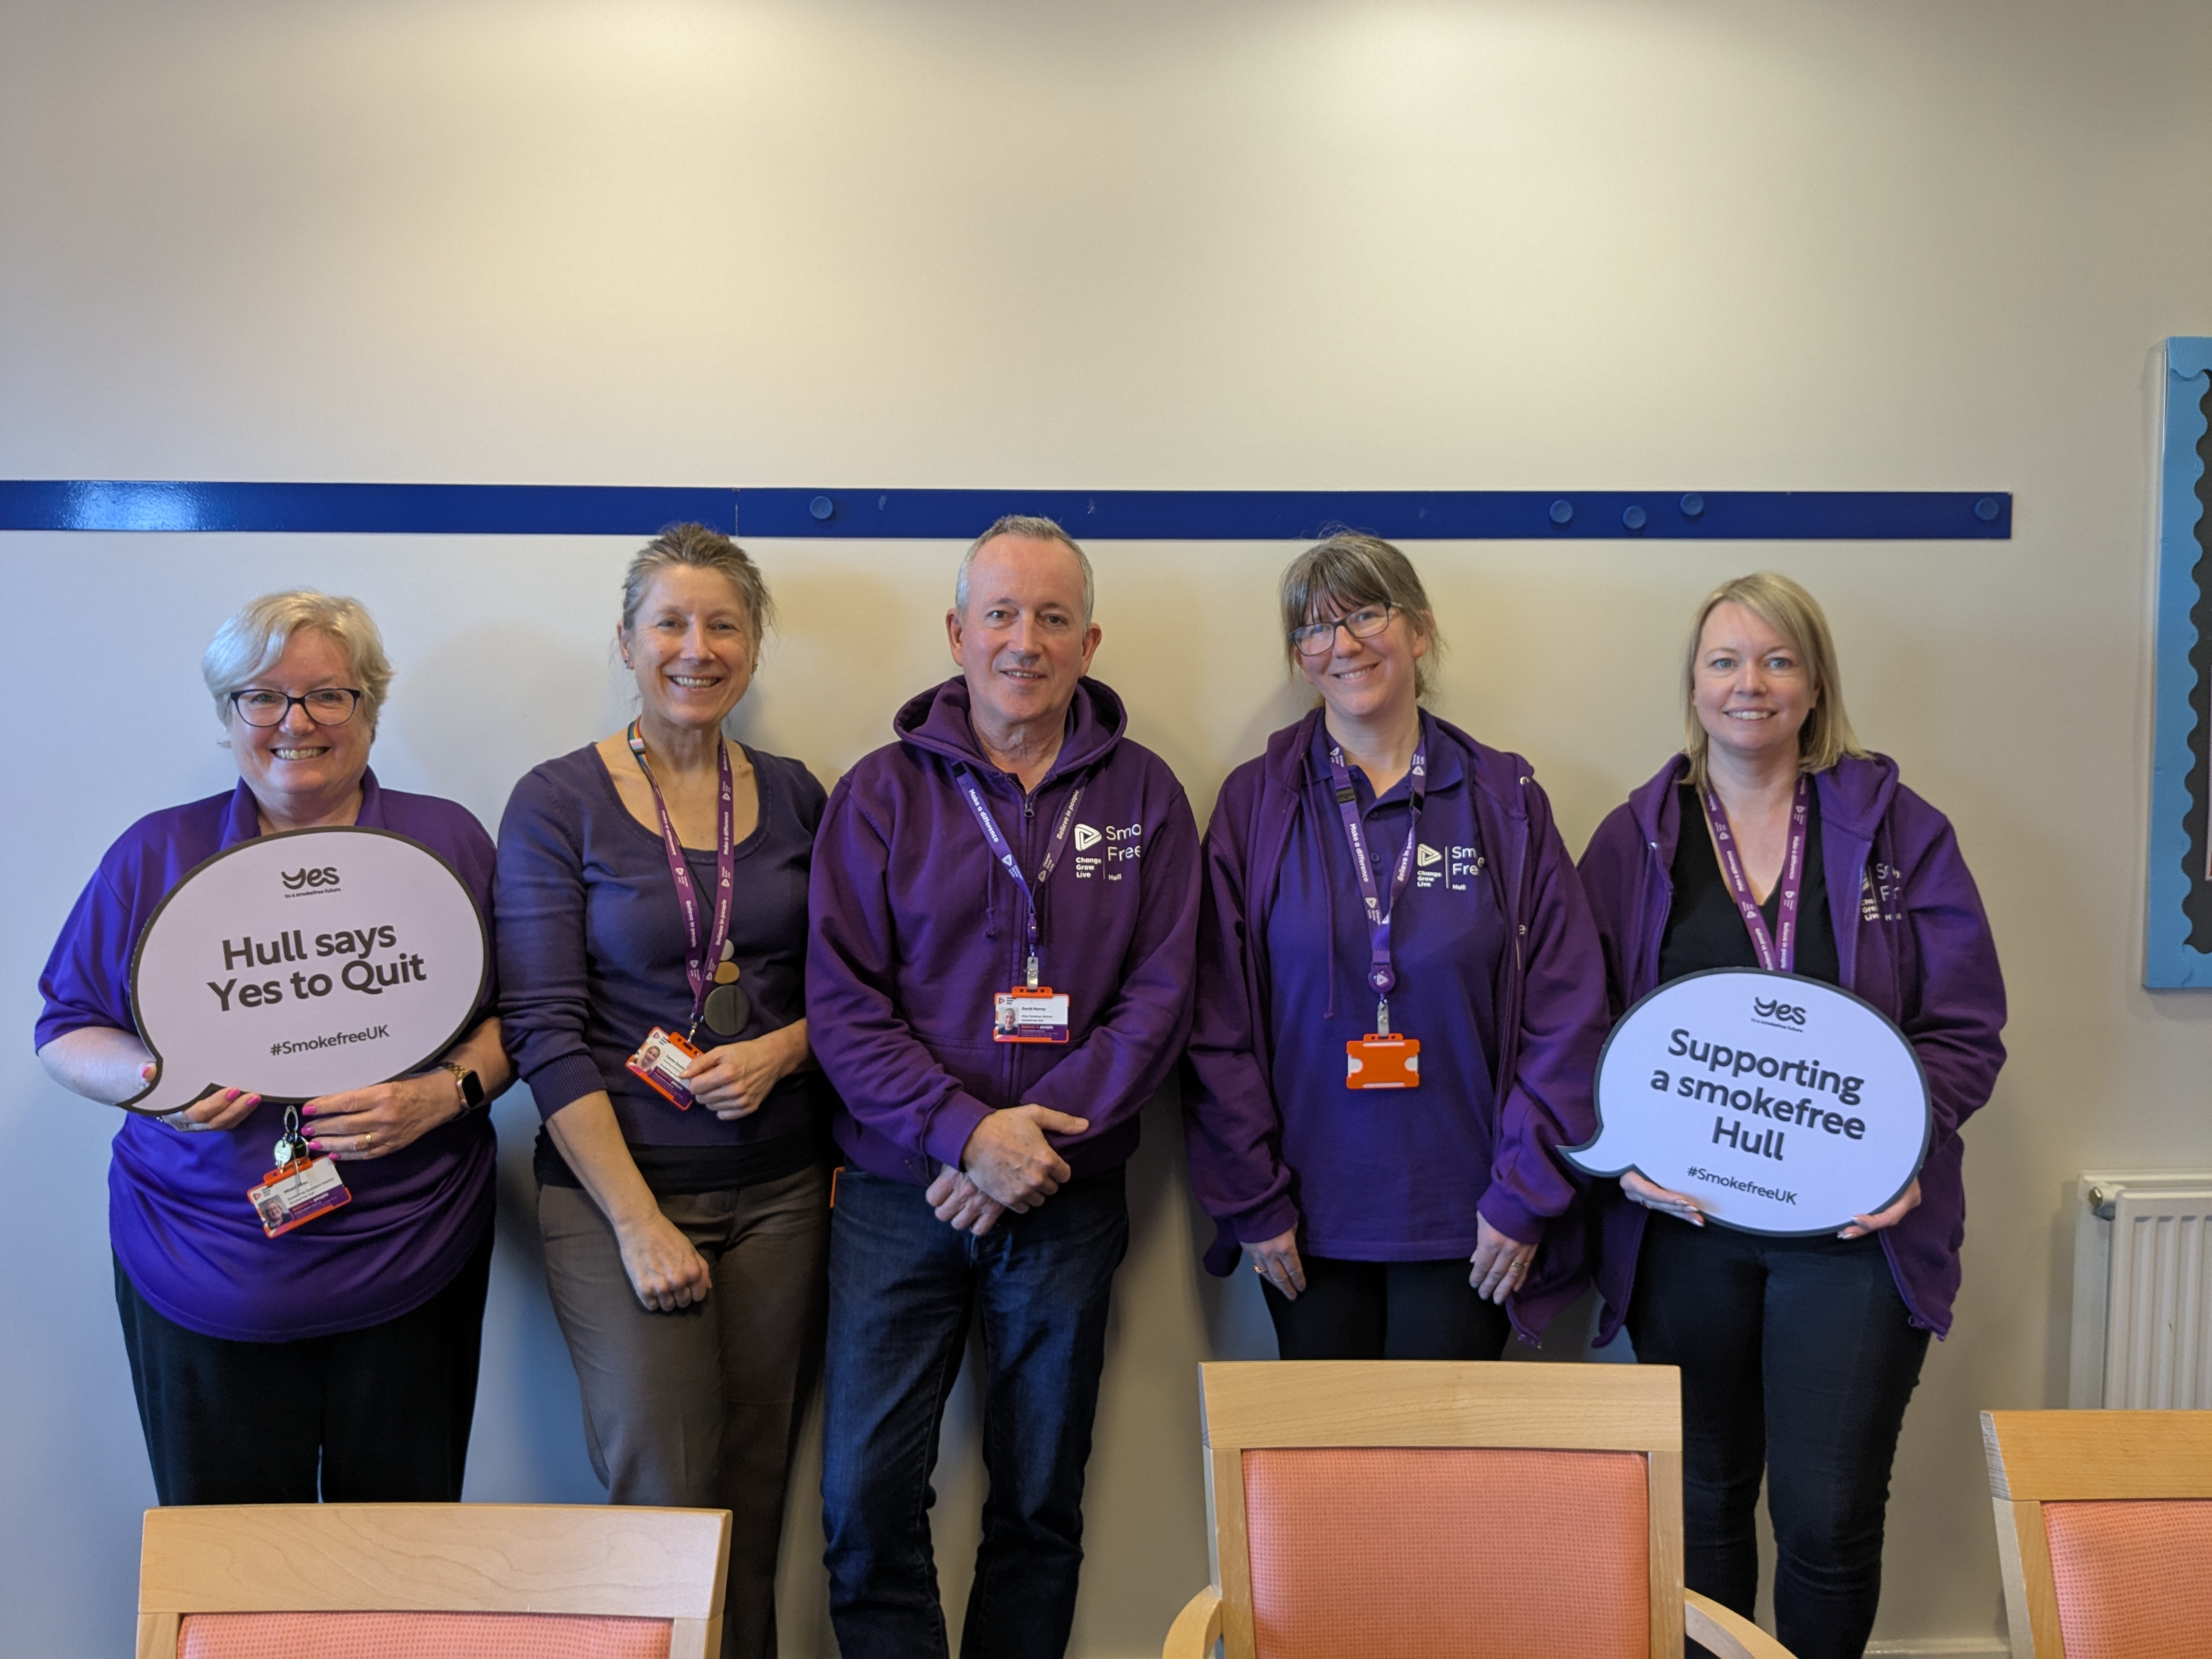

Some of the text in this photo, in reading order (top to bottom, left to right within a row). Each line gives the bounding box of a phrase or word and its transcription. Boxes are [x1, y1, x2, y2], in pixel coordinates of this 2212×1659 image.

[968, 788, 980, 806] Make
[980, 811, 999, 843] difference
[1056, 816, 1069, 840] Believe
[1106, 823, 1141, 840] Smo
[1350, 823, 1358, 842] Make
[281, 867, 340, 890] yes
[222, 925, 397, 970] Hull says
[206, 952, 427, 1012] Yes to Quit
[1753, 997, 1807, 1025] yes
[269, 1024, 391, 1057] #SmokefreeUK
[1668, 1028, 1865, 1105] Supporting
[1651, 1069, 1866, 1140] a smokefree
[1712, 1116, 1785, 1161] Hull
[1688, 1166, 1798, 1206] #SmokefreeUK
